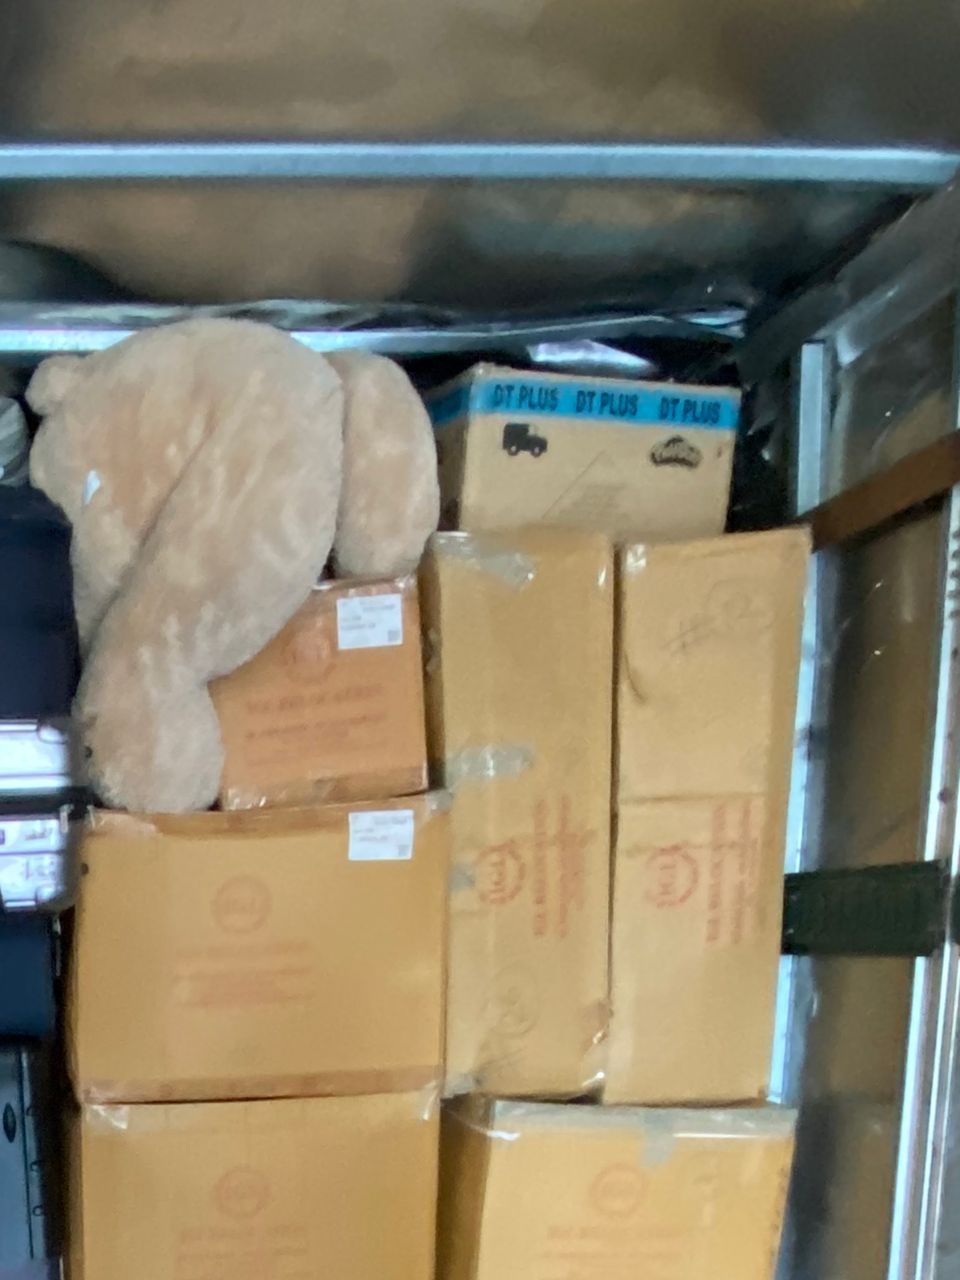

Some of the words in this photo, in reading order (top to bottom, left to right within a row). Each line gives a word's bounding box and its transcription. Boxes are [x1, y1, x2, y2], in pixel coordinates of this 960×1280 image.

[494, 385, 514, 406] DT
[518, 385, 559, 410] PLUS
[576, 390, 596, 412] DT
[599, 392, 638, 416] PLUS
[660, 397, 679, 420] DT
[683, 399, 721, 424] PLUS
